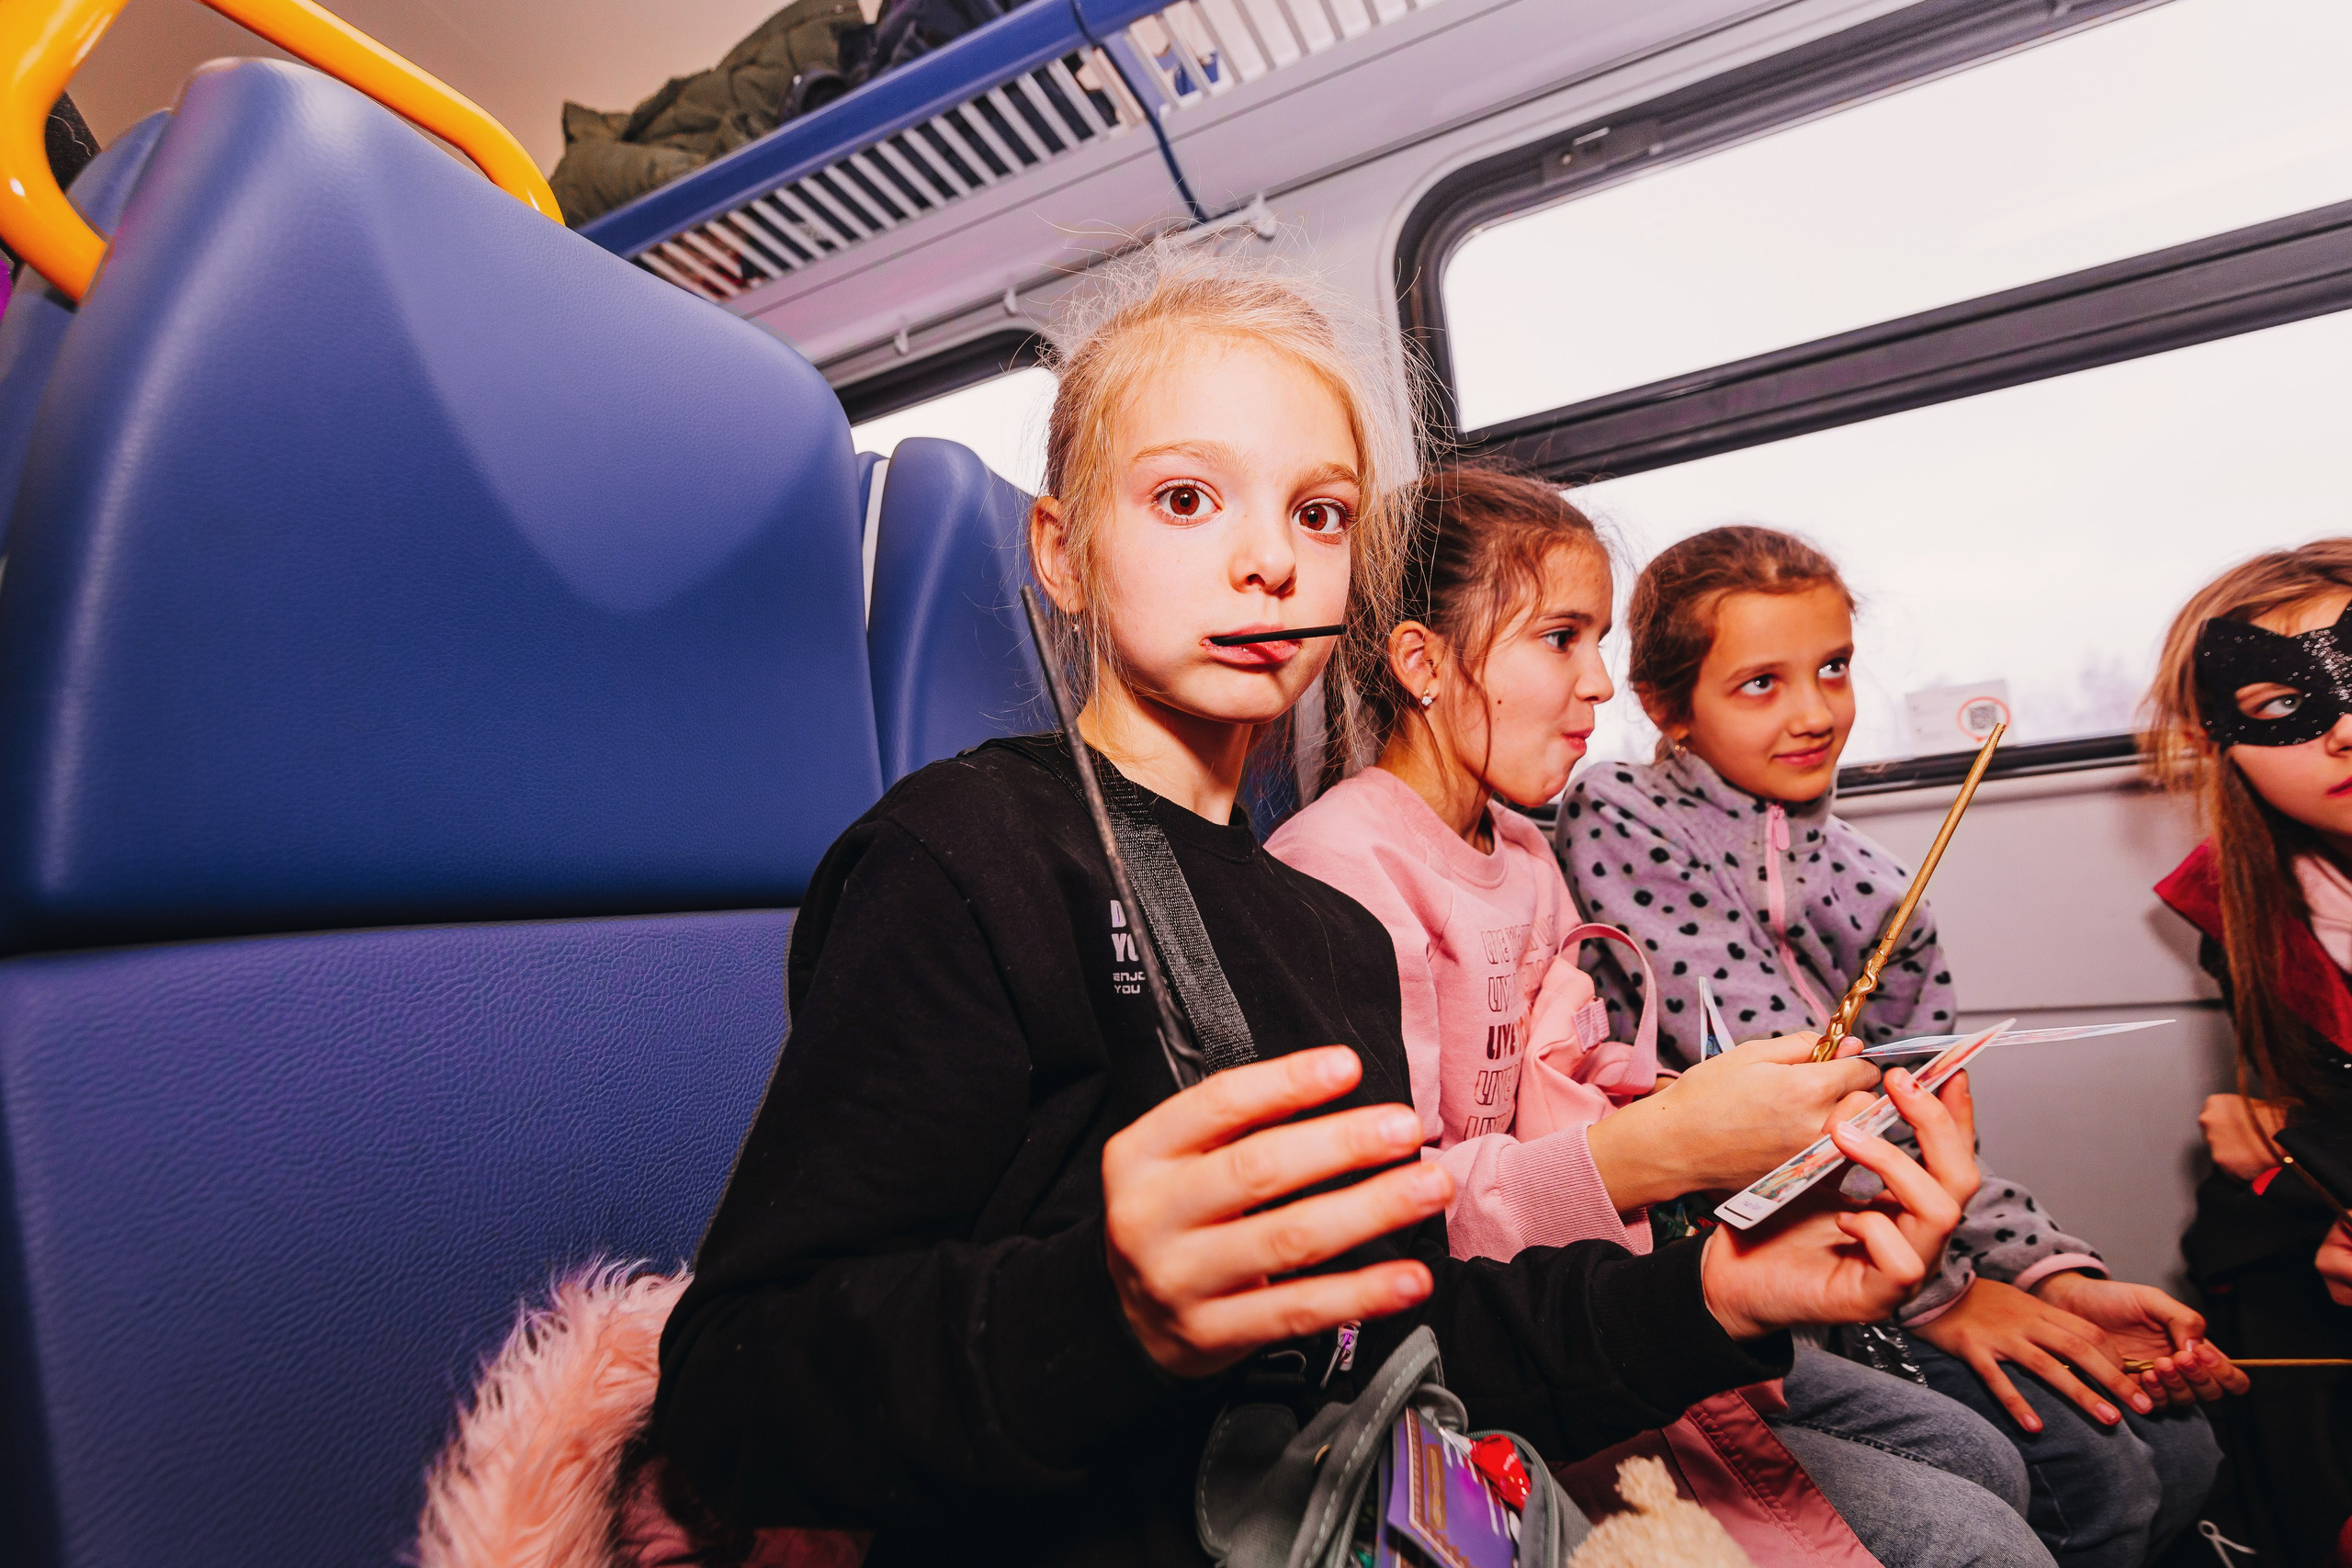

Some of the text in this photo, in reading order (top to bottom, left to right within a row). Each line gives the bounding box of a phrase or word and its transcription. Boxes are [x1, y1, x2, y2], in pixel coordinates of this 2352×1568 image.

[1111, 933, 1139, 962] YO
[1113, 972, 1146, 981] ENJO
[1114, 984, 1140, 994] YOU
[1487, 1022, 1516, 1060] LIVE
